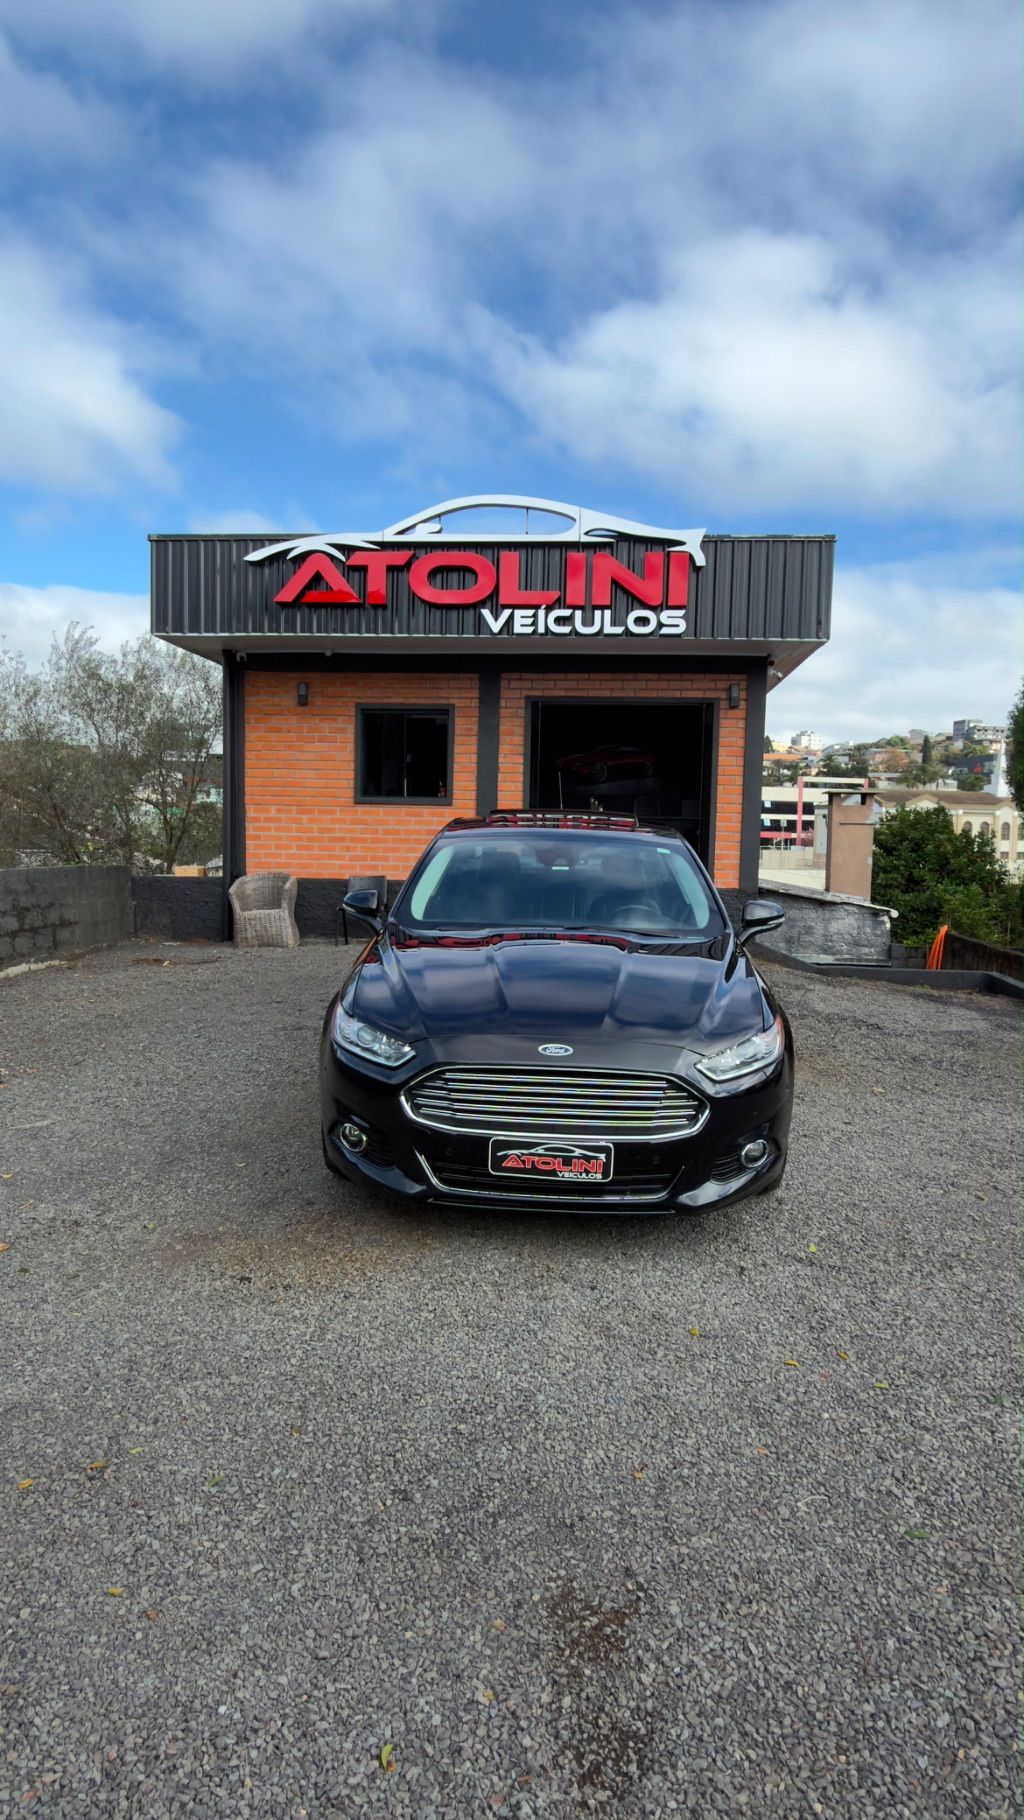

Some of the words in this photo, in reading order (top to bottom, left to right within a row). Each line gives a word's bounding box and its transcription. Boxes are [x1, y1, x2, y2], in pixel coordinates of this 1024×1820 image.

[273, 551, 689, 607] ATOLINI
[480, 604, 688, 635] VEÍCULOS
[545, 1046, 566, 1054] Ford
[502, 1154, 603, 1172] ATOLINI
